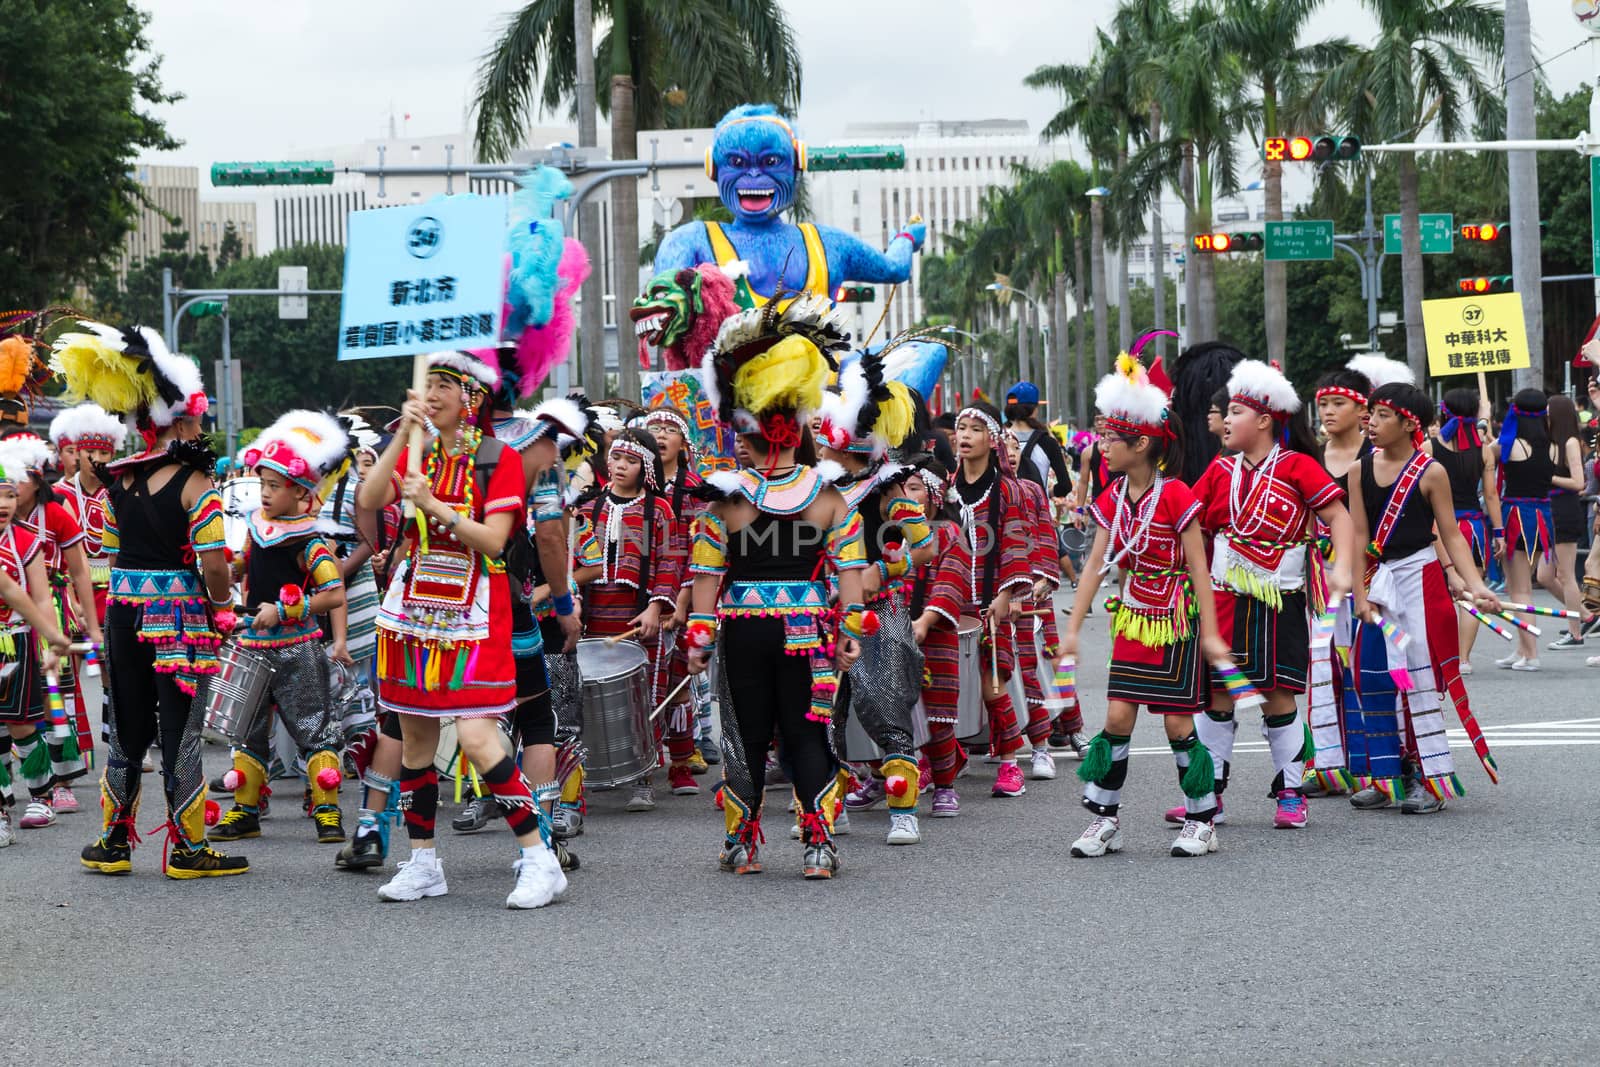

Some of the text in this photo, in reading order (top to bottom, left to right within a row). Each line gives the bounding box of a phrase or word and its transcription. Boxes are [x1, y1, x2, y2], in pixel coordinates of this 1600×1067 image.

[1265, 140, 1285, 160] 52
[1195, 235, 1210, 249] 47
[1461, 226, 1476, 239] 47
[391, 275, 456, 306] 新北市
[1466, 310, 1481, 320] 37
[1445, 328, 1507, 347] 中華科大
[1448, 349, 1511, 368] 建築視傳
